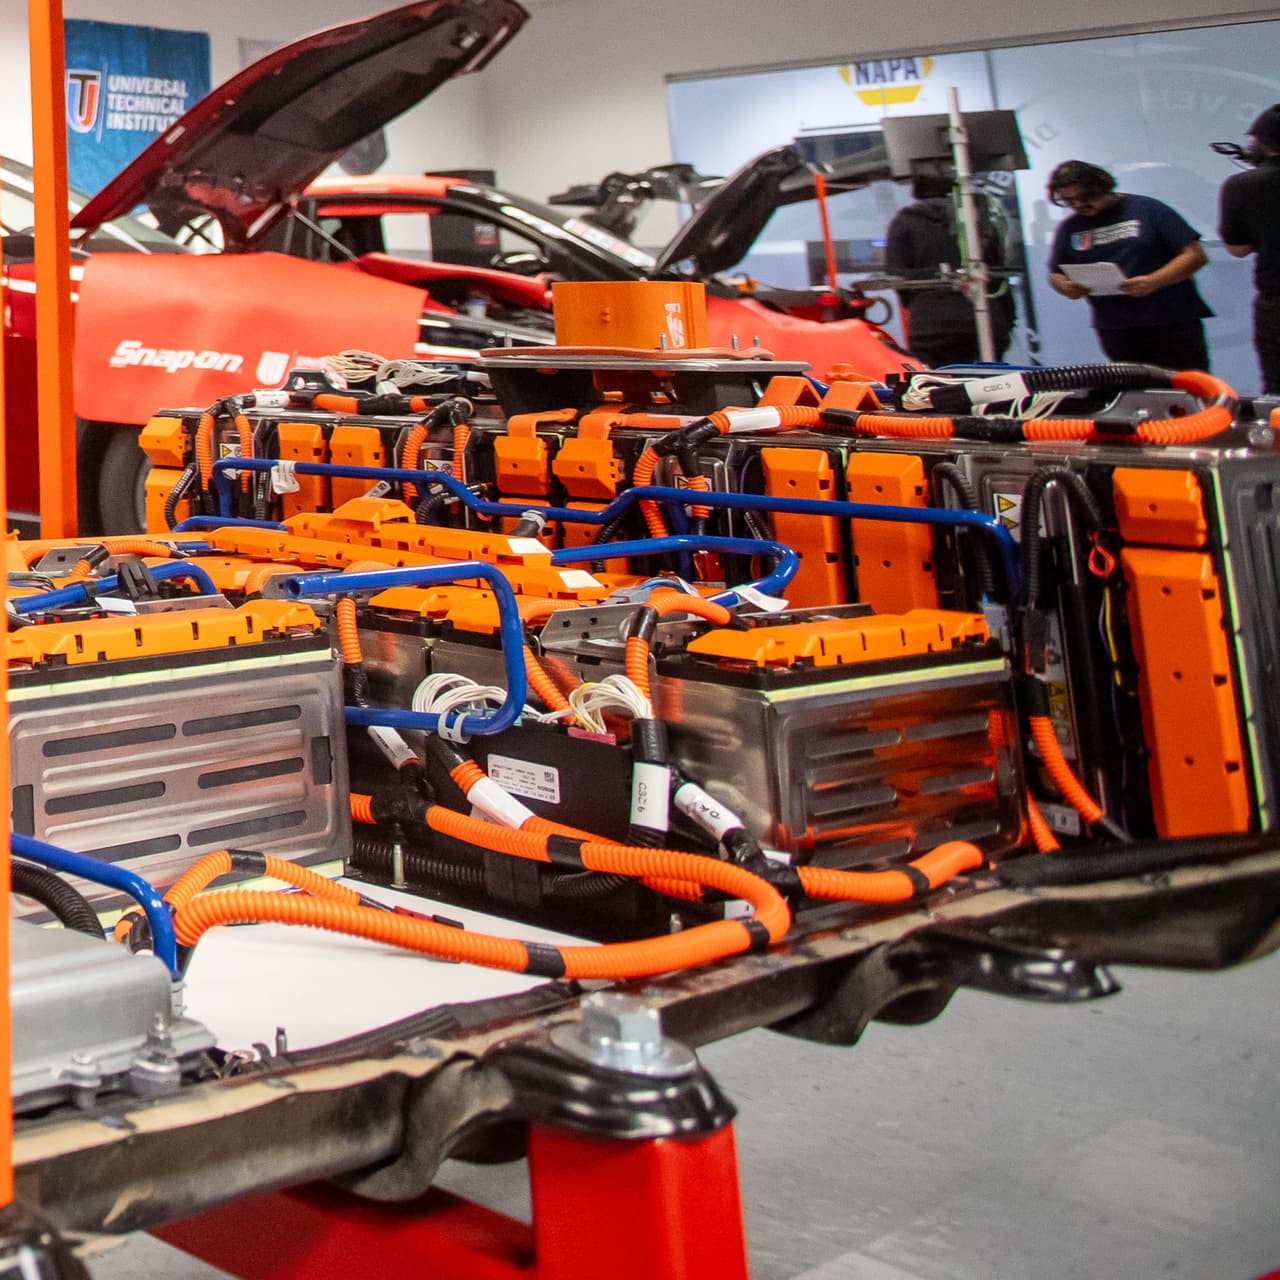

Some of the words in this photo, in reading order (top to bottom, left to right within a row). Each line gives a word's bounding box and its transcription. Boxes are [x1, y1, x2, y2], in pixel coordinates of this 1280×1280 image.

[854, 57, 920, 86] NAPA
[108, 74, 189, 97] UNIVERSAL
[107, 93, 185, 116] TECHNICAL
[110, 340, 244, 374] Snap-on
